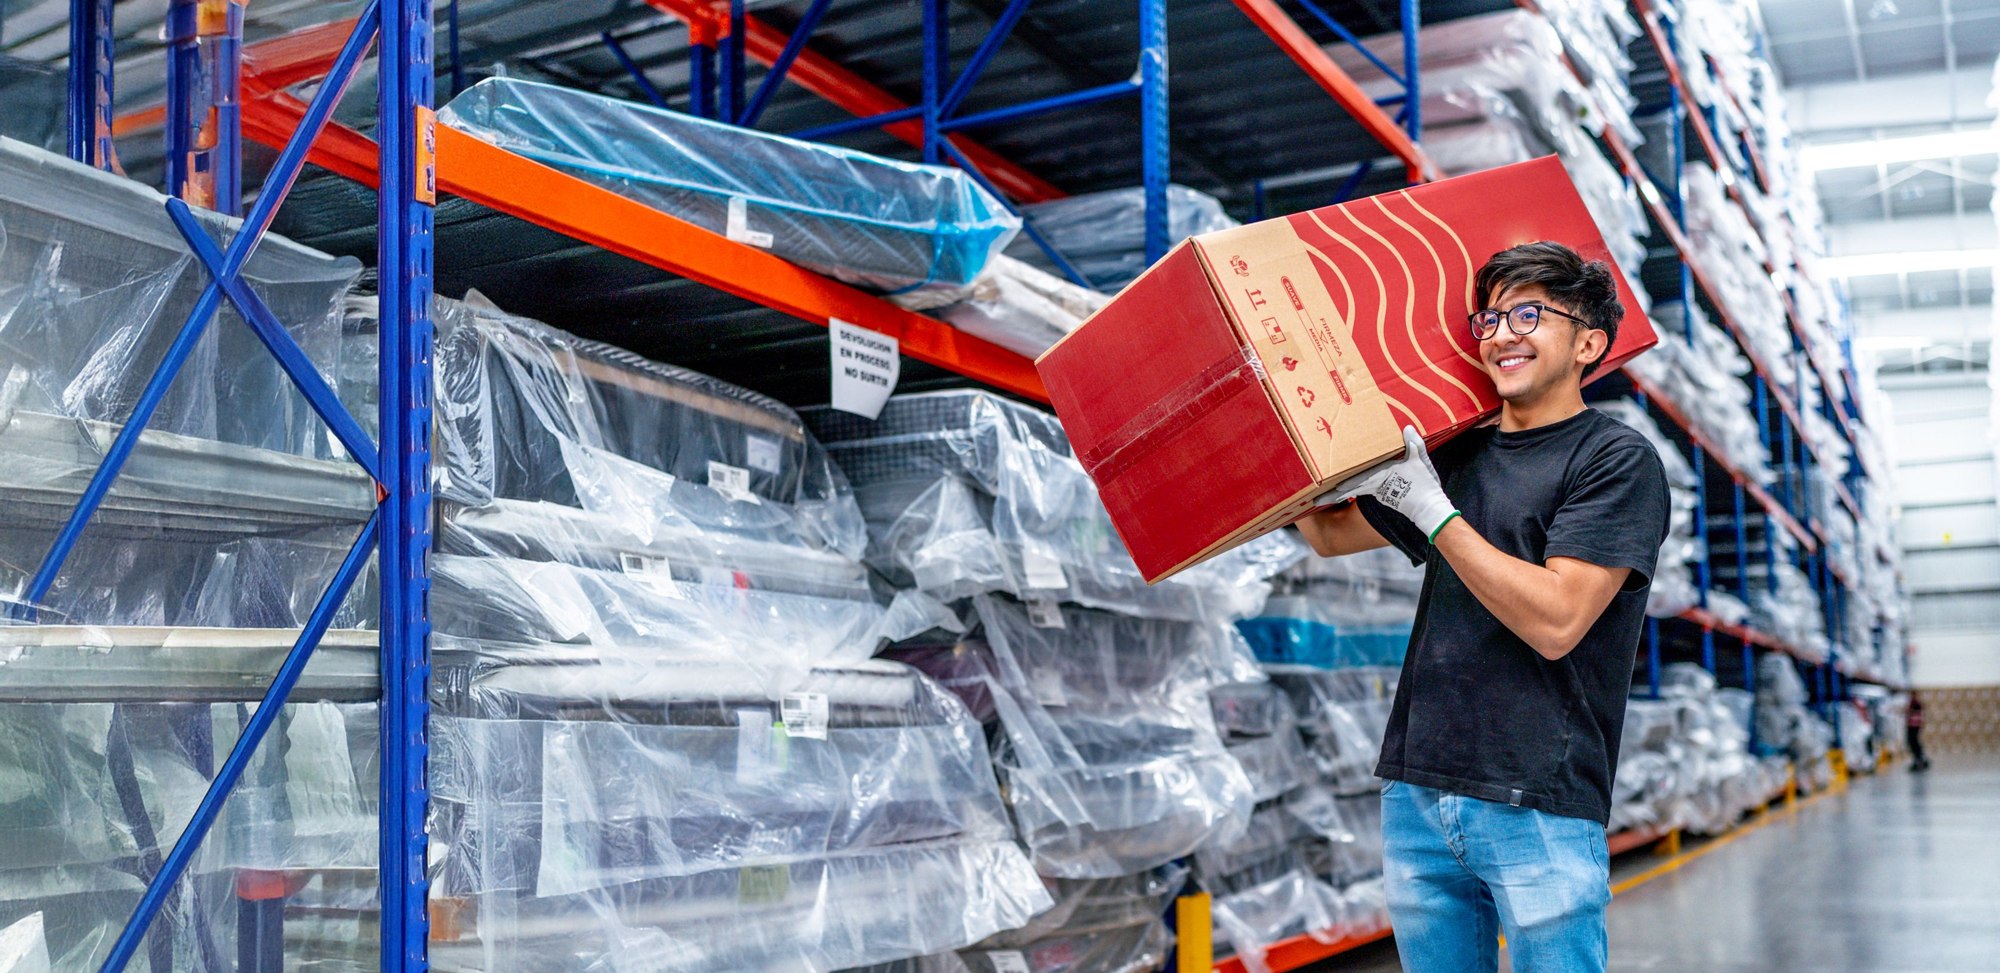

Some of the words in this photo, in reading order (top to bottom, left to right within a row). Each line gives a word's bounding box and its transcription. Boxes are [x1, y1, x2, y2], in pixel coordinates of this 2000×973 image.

[1284, 281, 1300, 306] SUAVE
[1309, 328, 1323, 352] MEDIA
[1333, 375, 1348, 399] FIRME
[1320, 317, 1342, 357] FIRMEZA
[840, 347, 852, 358] EN
[845, 366, 858, 378] NO
[860, 371, 888, 387] SURTIR
